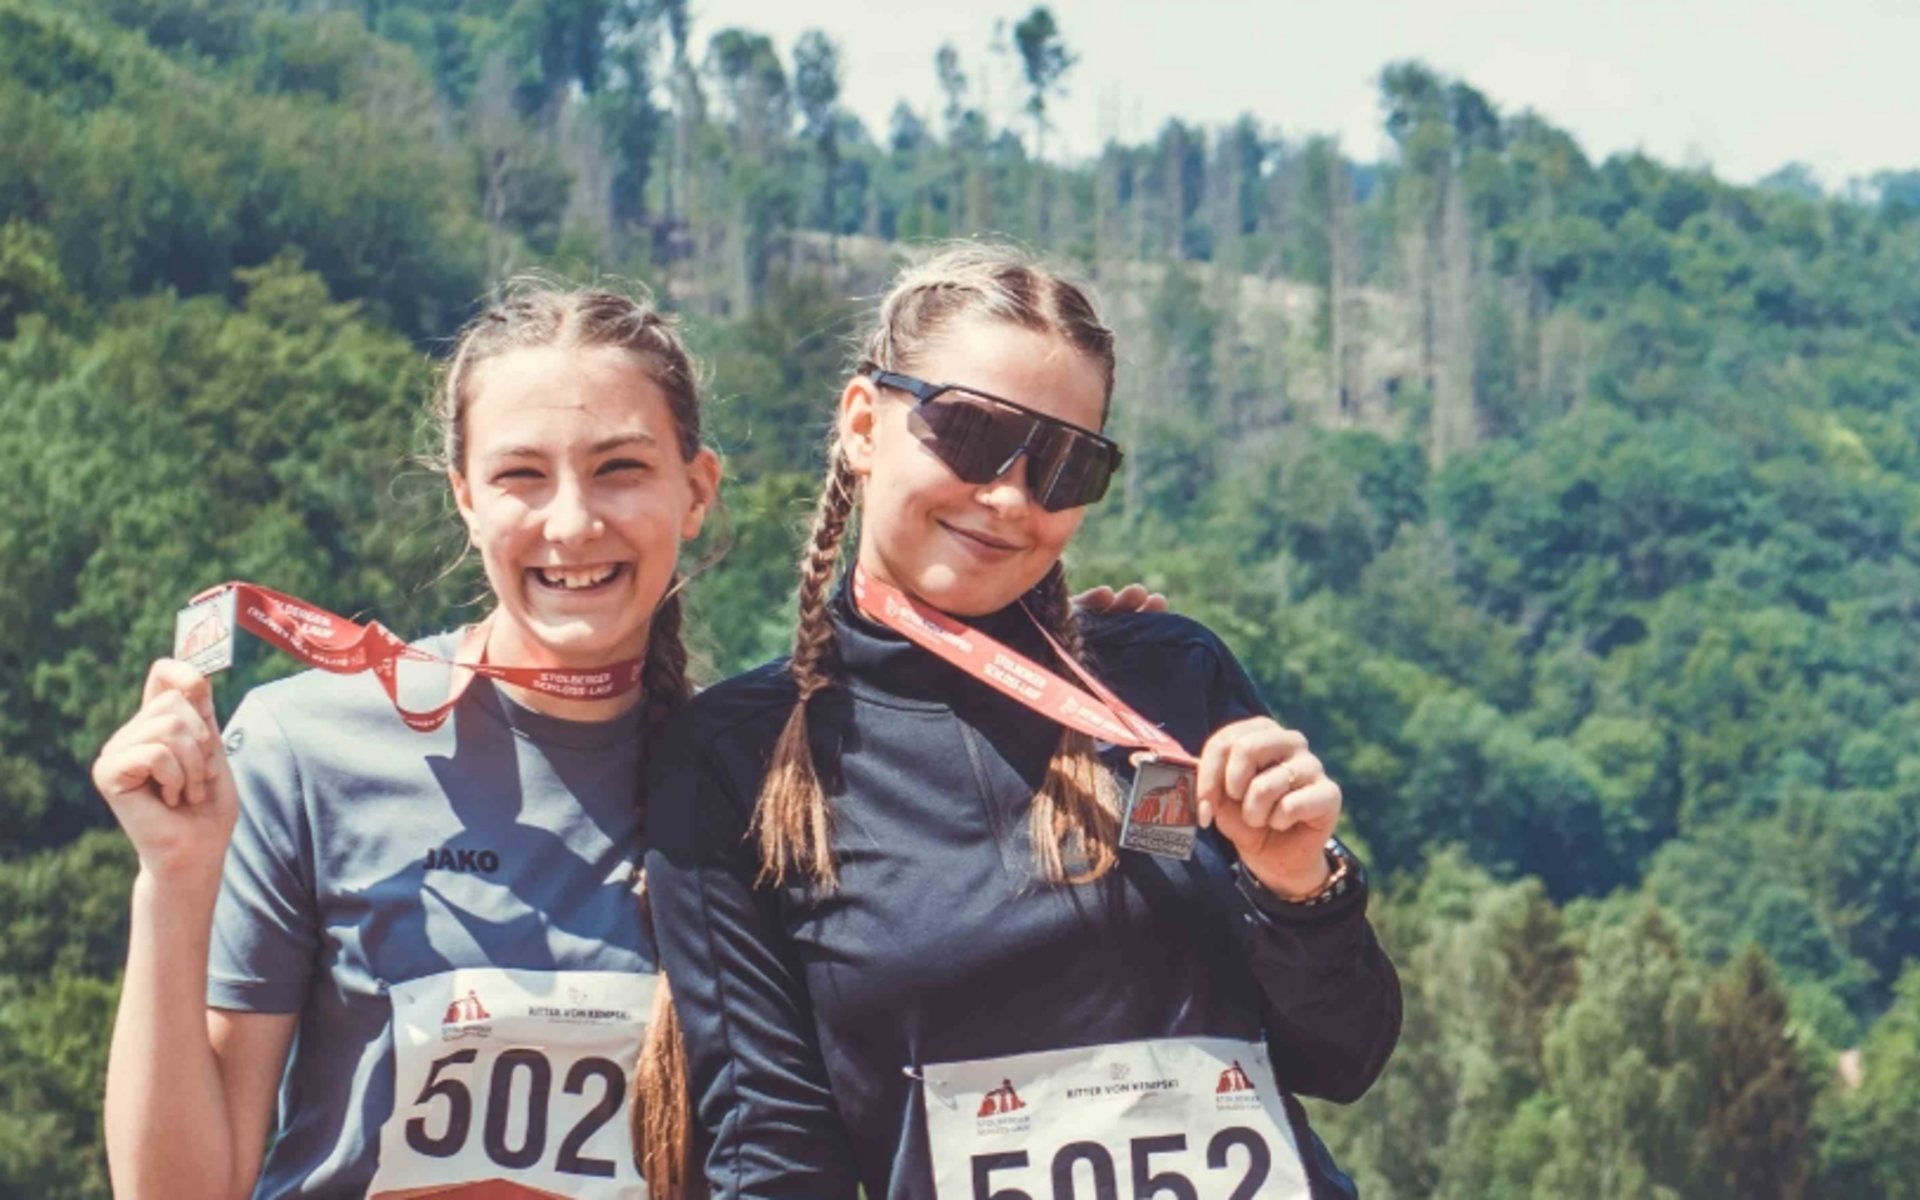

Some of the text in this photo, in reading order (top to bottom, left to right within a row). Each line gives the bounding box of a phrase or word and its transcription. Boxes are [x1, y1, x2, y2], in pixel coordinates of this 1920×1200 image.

[423, 848, 500, 873] JAKO
[1067, 1086, 1101, 1099] RITTER
[1105, 1083, 1130, 1095] VON
